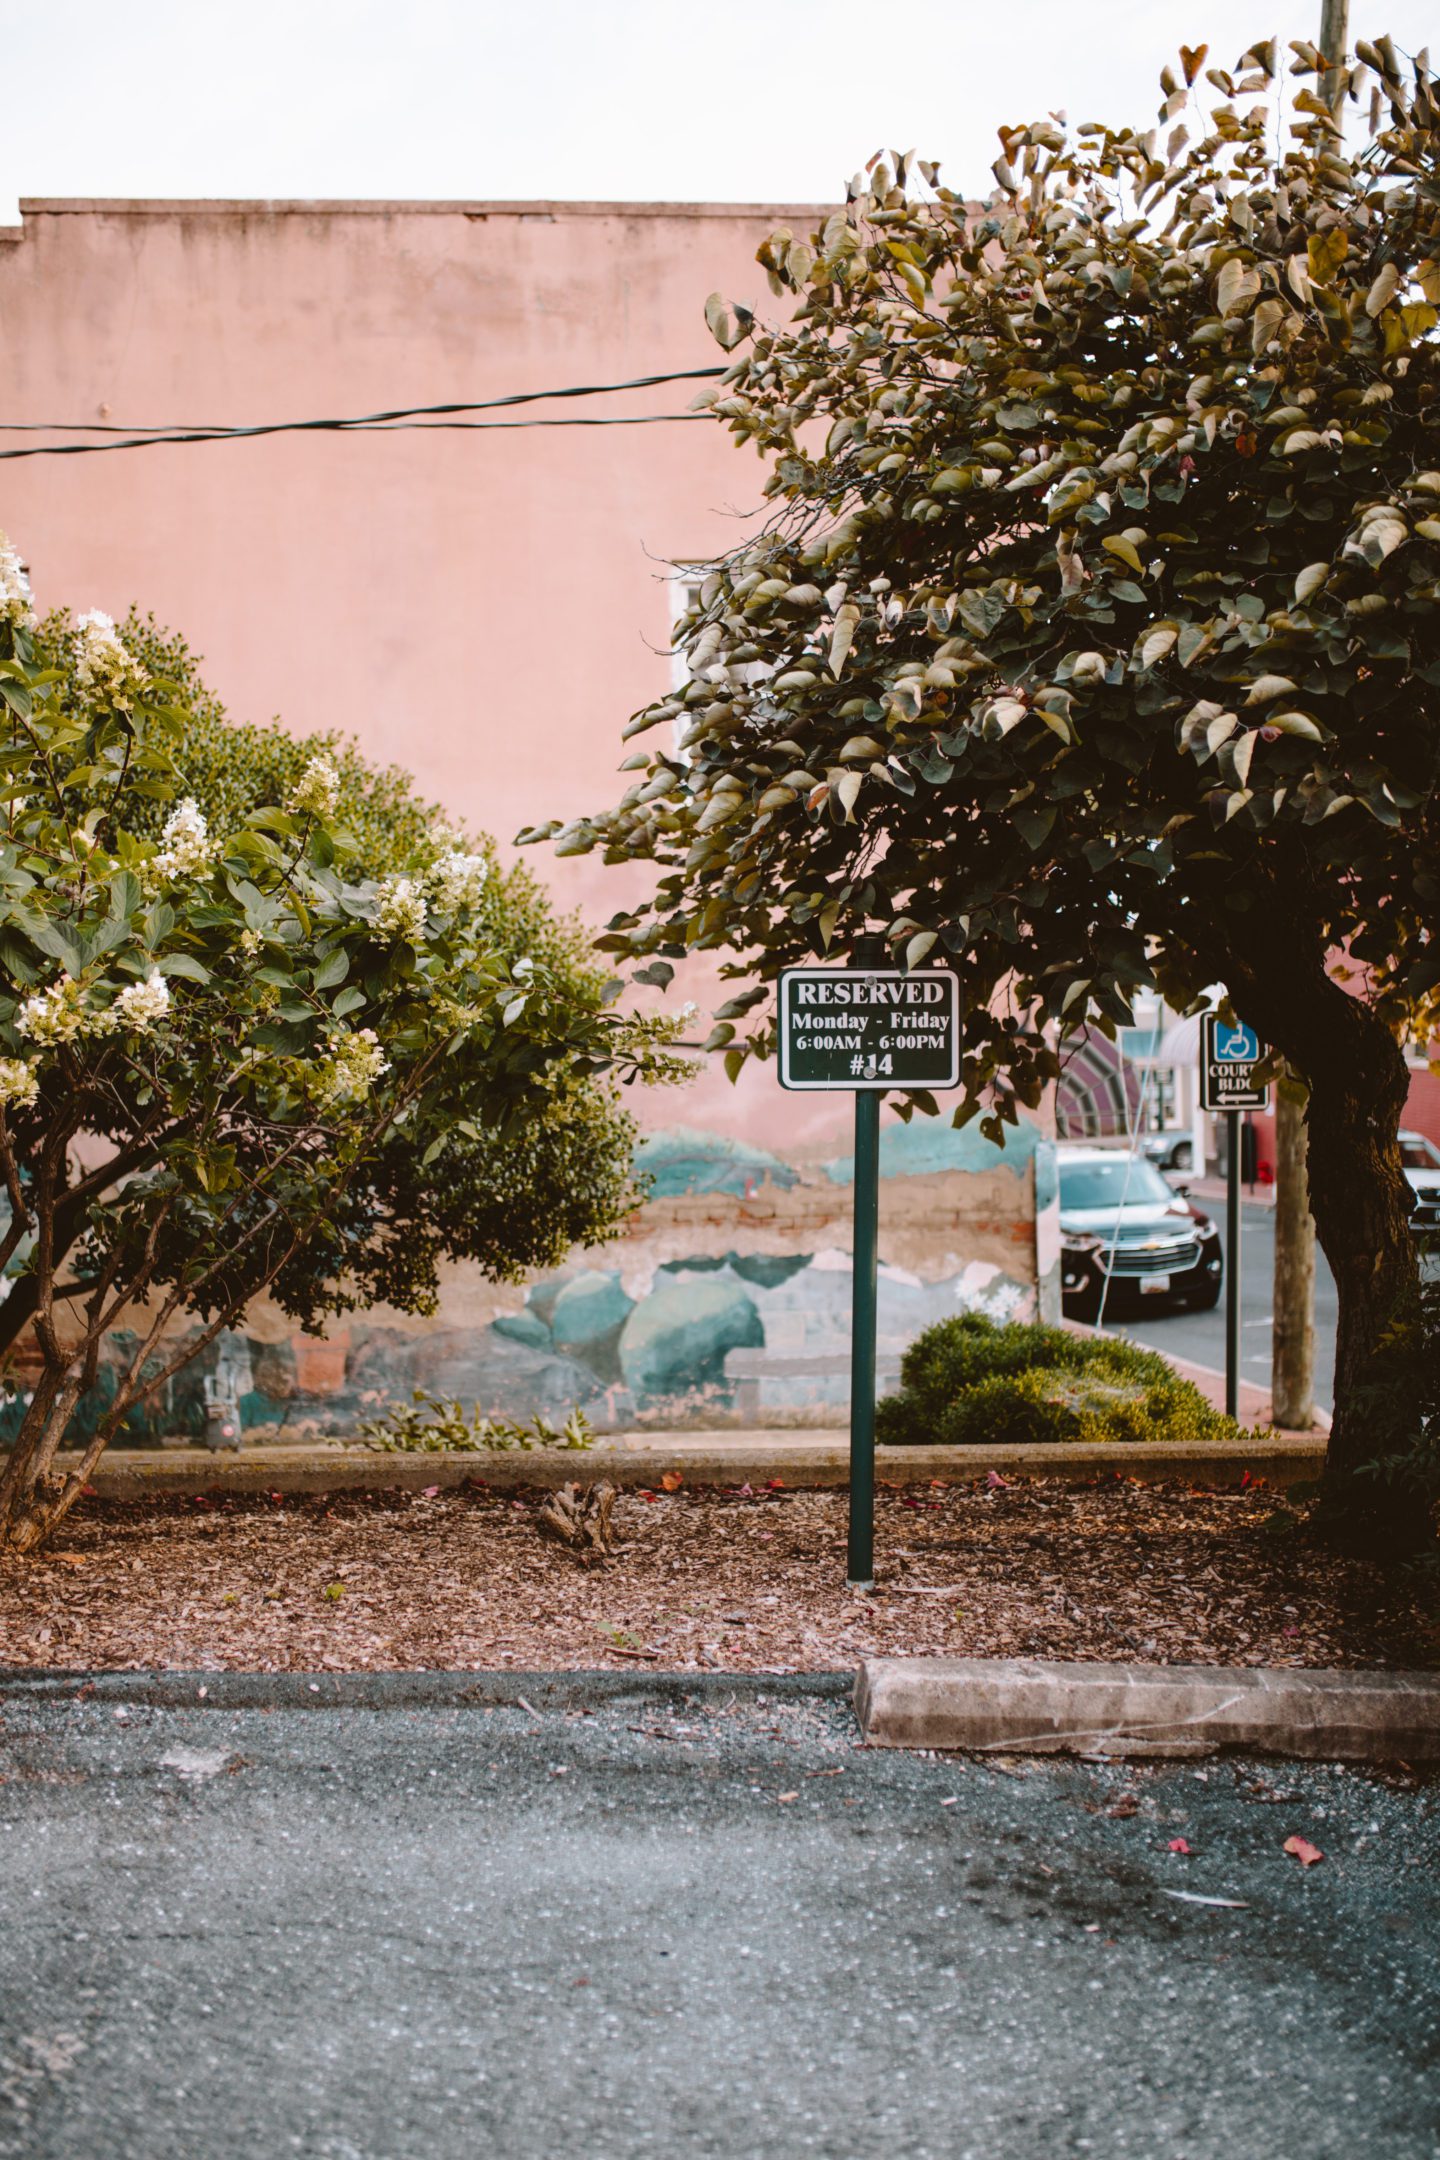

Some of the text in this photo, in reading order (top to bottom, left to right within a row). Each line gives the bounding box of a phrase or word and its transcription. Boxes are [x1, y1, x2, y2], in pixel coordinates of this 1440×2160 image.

[798, 983, 944, 1004] RESERVED
[792, 1012, 869, 1031] Monday
[890, 1011, 950, 1031] Friday
[796, 1035, 861, 1049] 6:00AM
[879, 1035, 945, 1049] 6:00PM
[850, 1053, 893, 1075] #14
